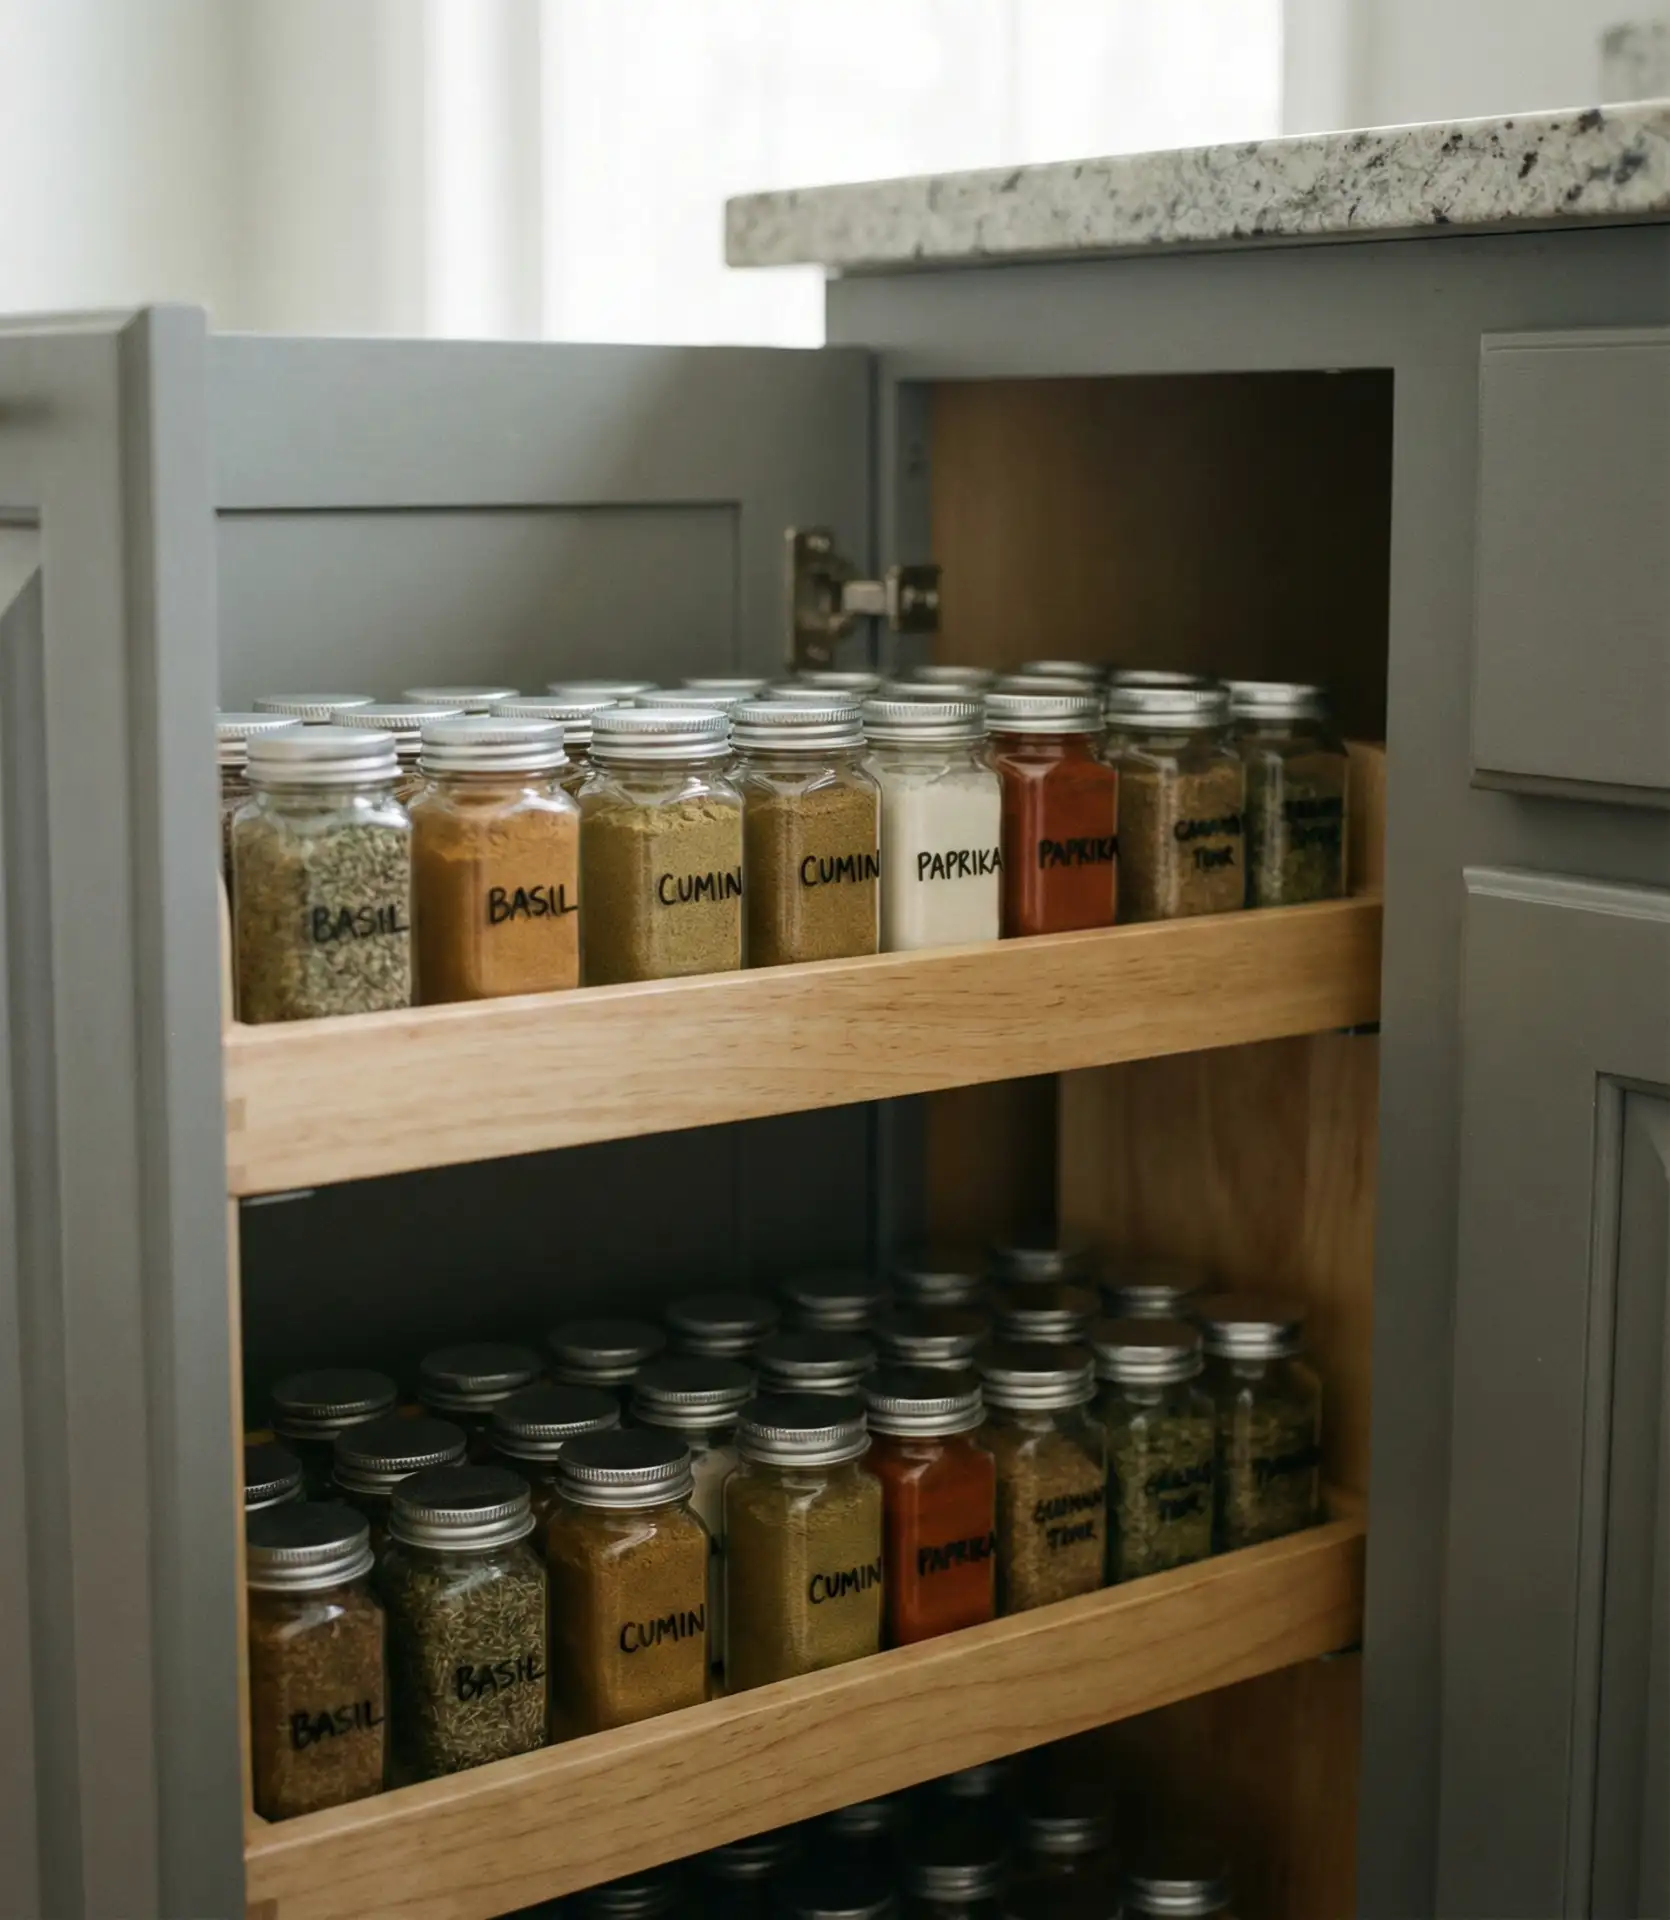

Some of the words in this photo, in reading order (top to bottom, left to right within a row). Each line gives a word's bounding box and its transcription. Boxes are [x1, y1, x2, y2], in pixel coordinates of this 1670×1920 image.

[801, 850, 880, 886] CUMIN
[918, 848, 1003, 881] PAPRIKA
[1039, 835, 1121, 868] PAPRIKA
[488, 885, 577, 924] BASIL
[659, 867, 743, 905] CUMIN
[313, 905, 409, 943] BASIL
[918, 1531, 997, 1577] PAPRIKA
[809, 1558, 882, 1604] CUMIN
[620, 1604, 705, 1653] CUMIN
[456, 1656, 545, 1700] BASIL
[291, 1702, 384, 1748] BASIL
